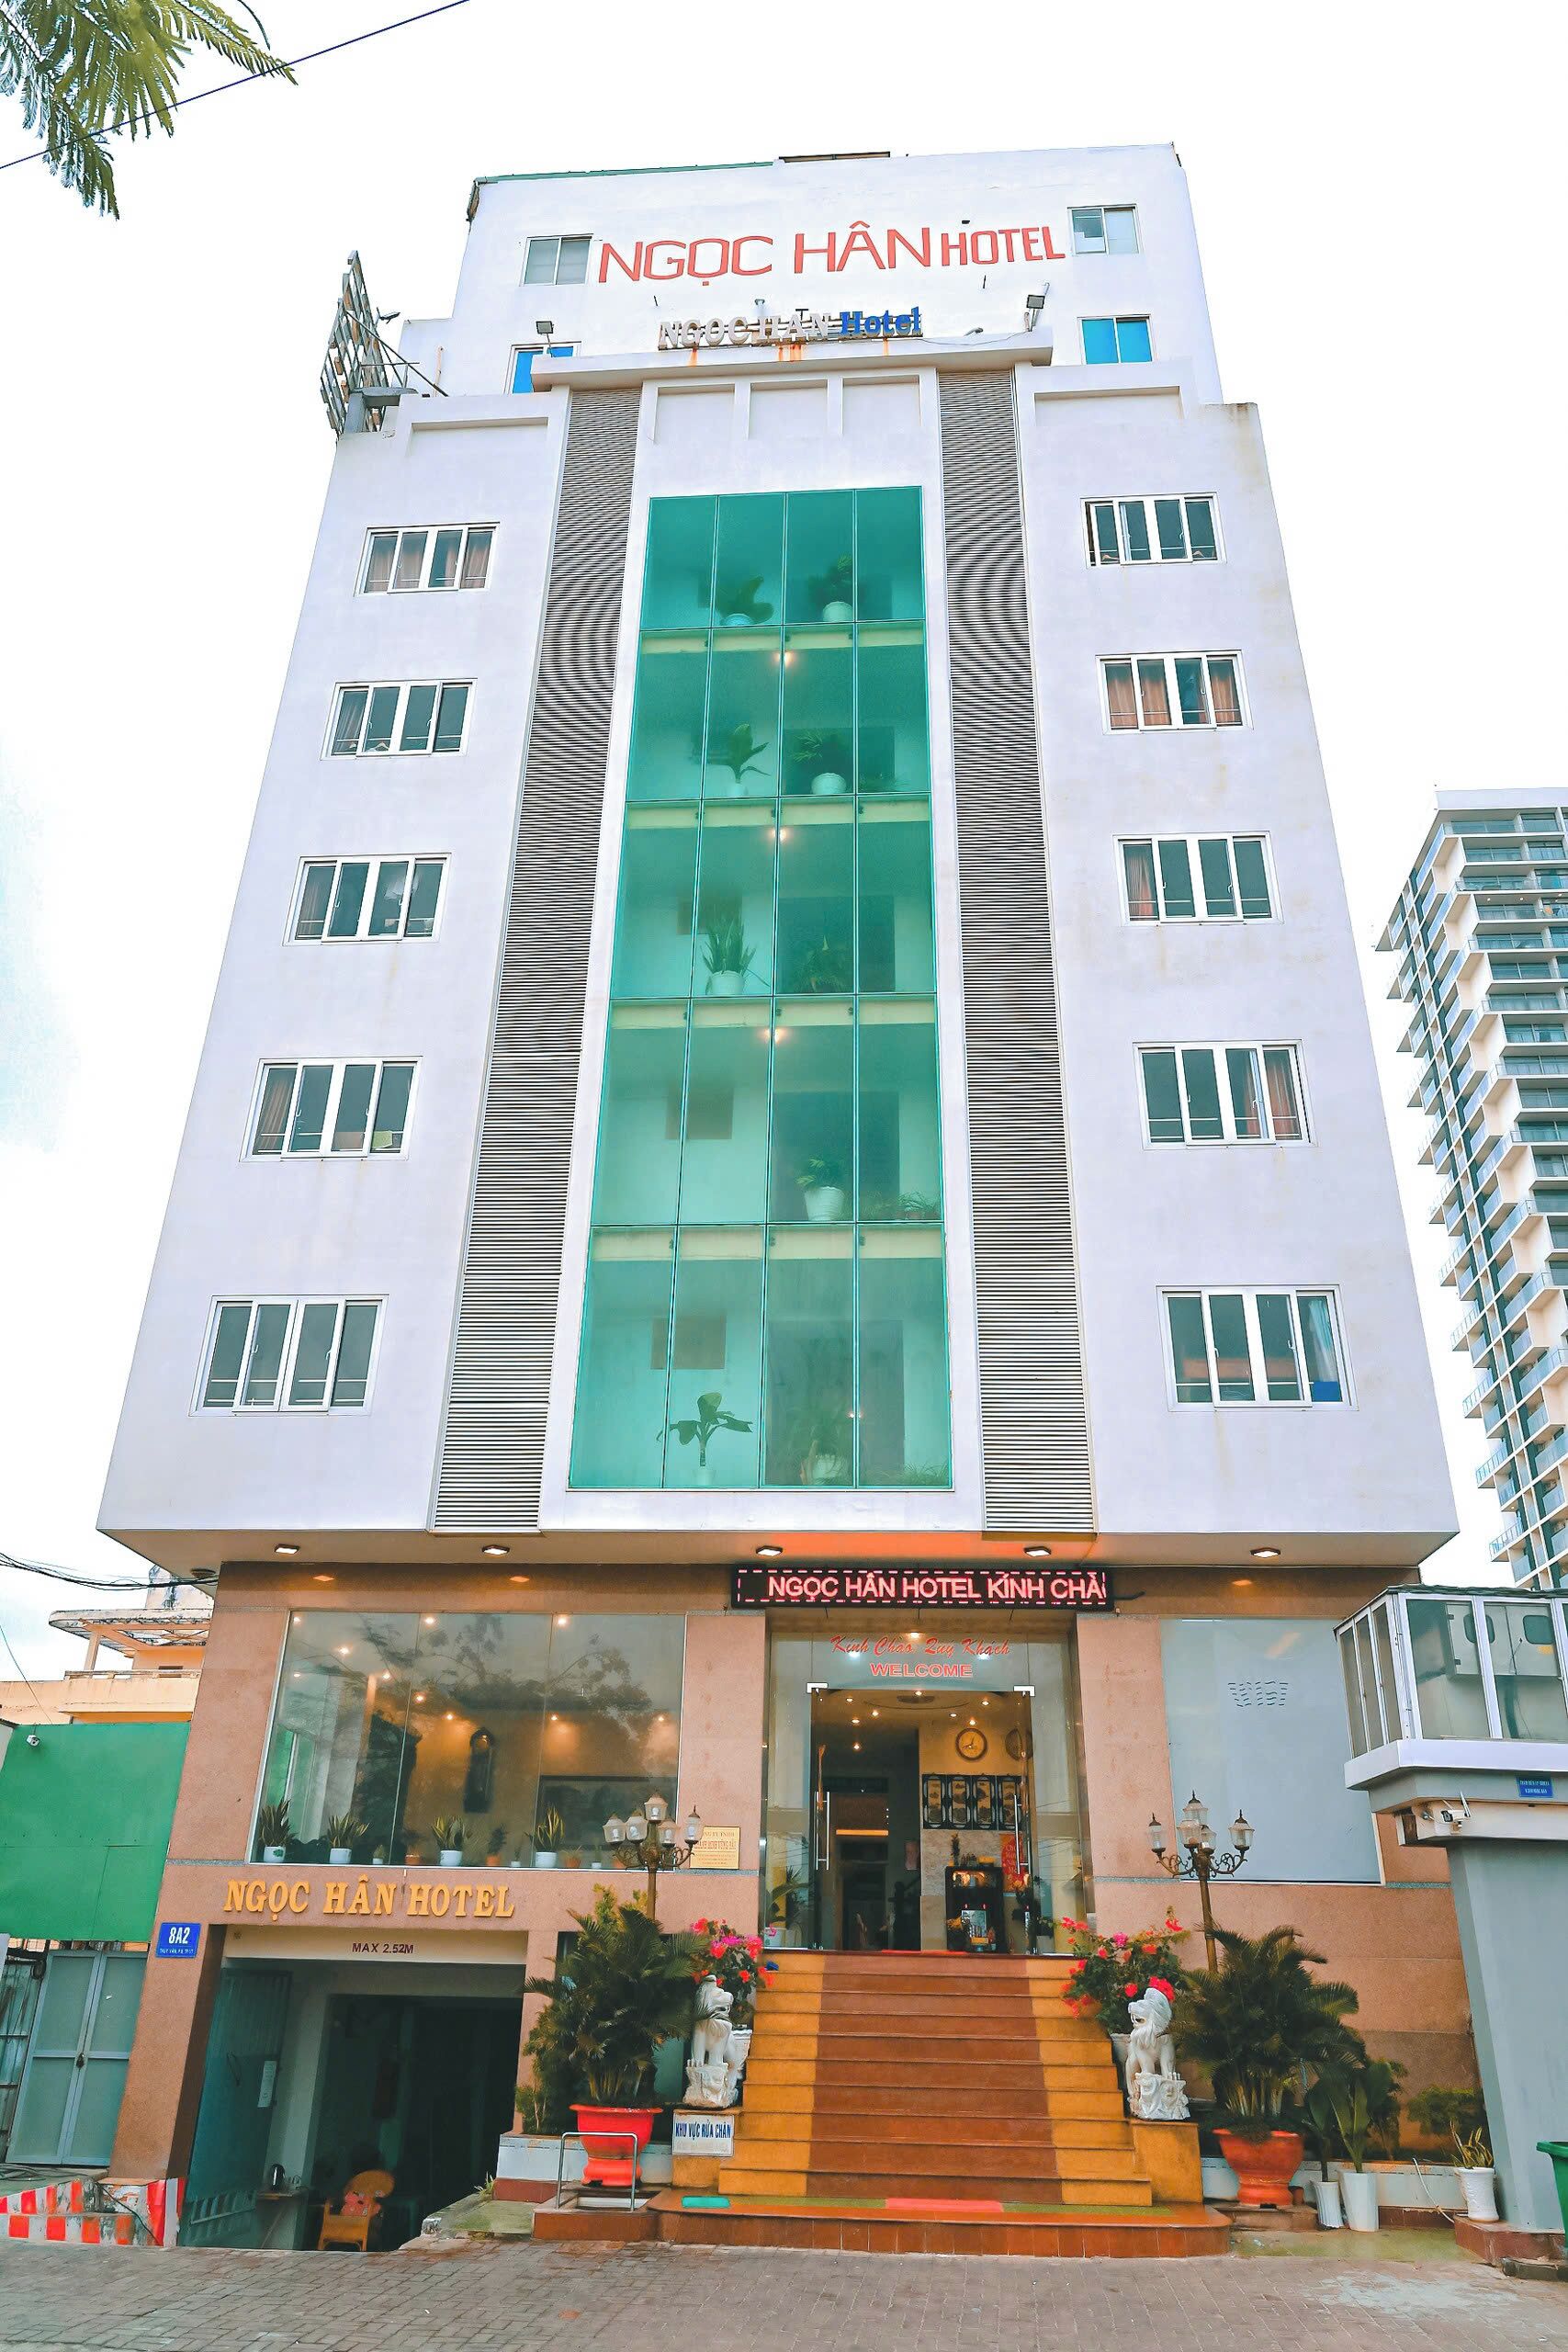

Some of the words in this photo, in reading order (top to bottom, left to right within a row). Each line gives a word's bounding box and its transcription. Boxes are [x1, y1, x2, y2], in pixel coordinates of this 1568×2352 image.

[598, 235, 773, 287] NGỌC
[794, 220, 931, 274] HÂN
[942, 226, 1066, 267] HOTEL
[839, 306, 923, 337] Hotel
[768, 1576, 840, 1601] NGỌC
[845, 1572, 896, 1599] HÂN
[902, 1577, 981, 1599] HOTEL
[987, 1572, 1045, 1600] KÍNH
[1050, 1573, 1107, 1600] CHÀ
[829, 1634, 870, 1653] Kính
[874, 1636, 915, 1657] Chào
[870, 1663, 974, 1678] WELCOME
[223, 1879, 310, 1921] NGỌC
[322, 1873, 398, 1916] HÂN
[406, 1883, 515, 1918] HOTEL
[168, 1927, 191, 1944] 8A2
[352, 1942, 379, 1952] MAX
[382, 1943, 414, 1954] 2.52M
[675, 2122, 687, 2137] KHU
[688, 2120, 701, 2141] VỰC
[715, 2121, 731, 2139] CHÂN
